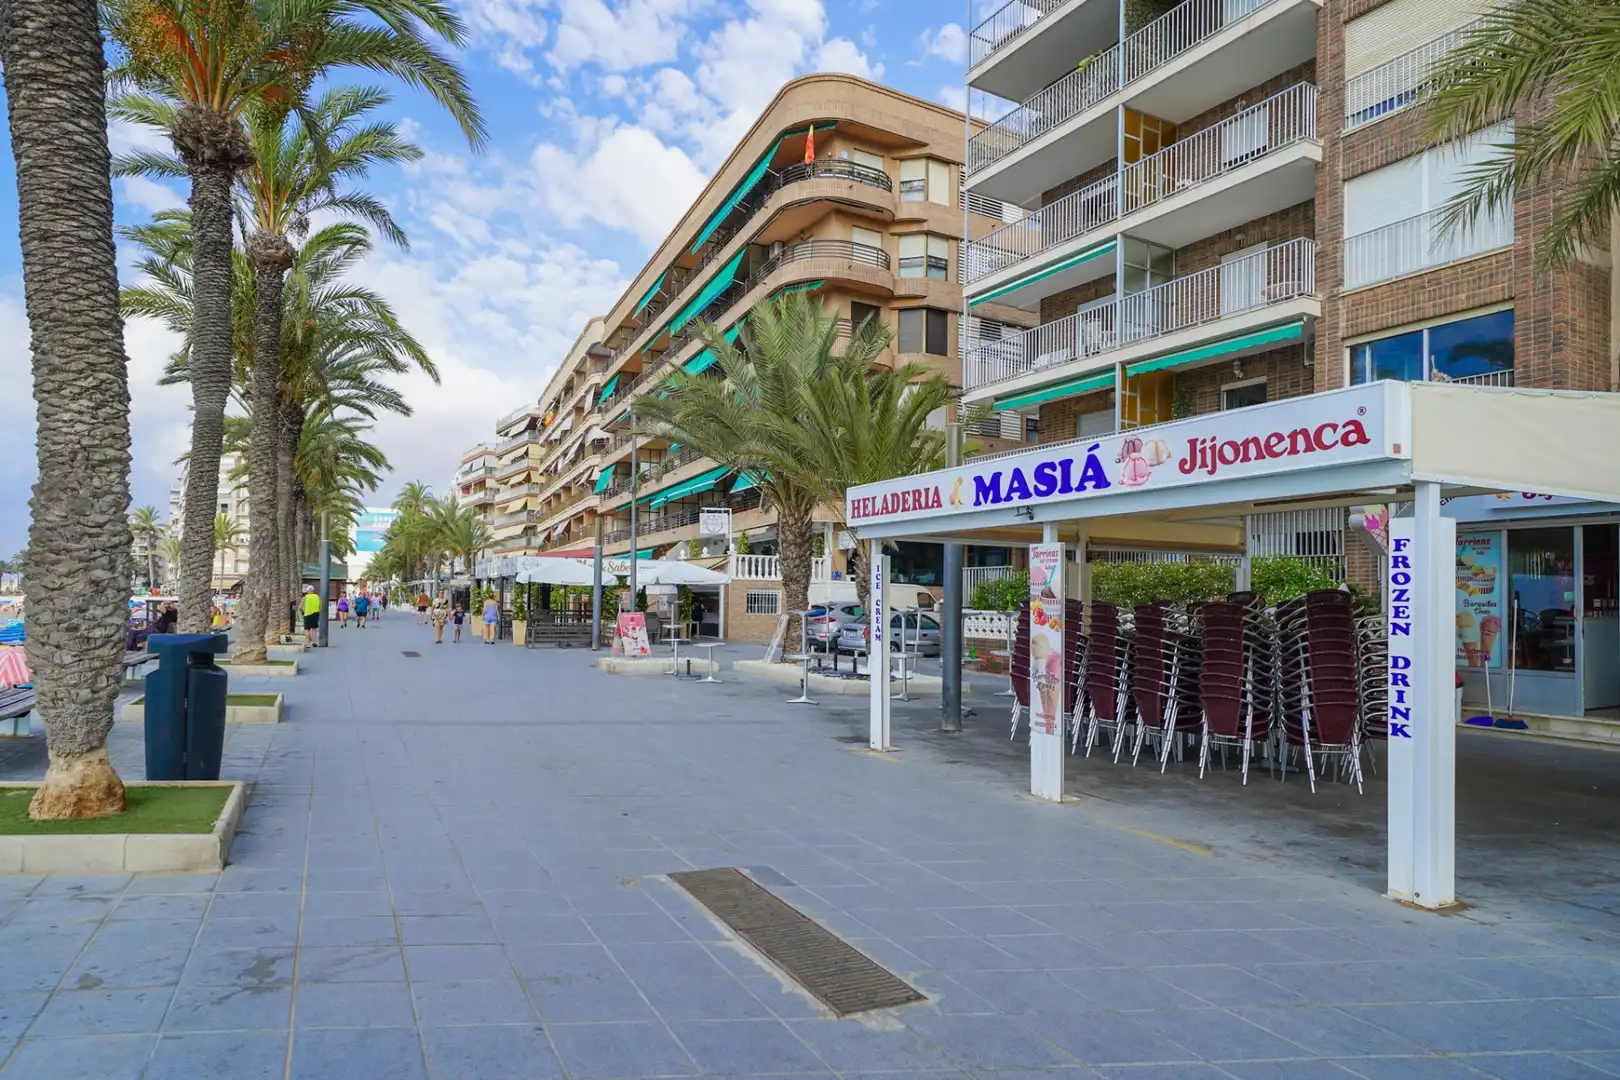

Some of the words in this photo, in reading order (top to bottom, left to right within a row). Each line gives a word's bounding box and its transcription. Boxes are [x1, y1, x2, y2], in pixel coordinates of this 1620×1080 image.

[851, 486, 943, 519] HELADERIA
[973, 443, 1111, 507] MASIÁ
[1179, 419, 1371, 475] Jijonenca
[1390, 538, 1411, 636] FROZEN
[1390, 655, 1412, 738] DRINK
